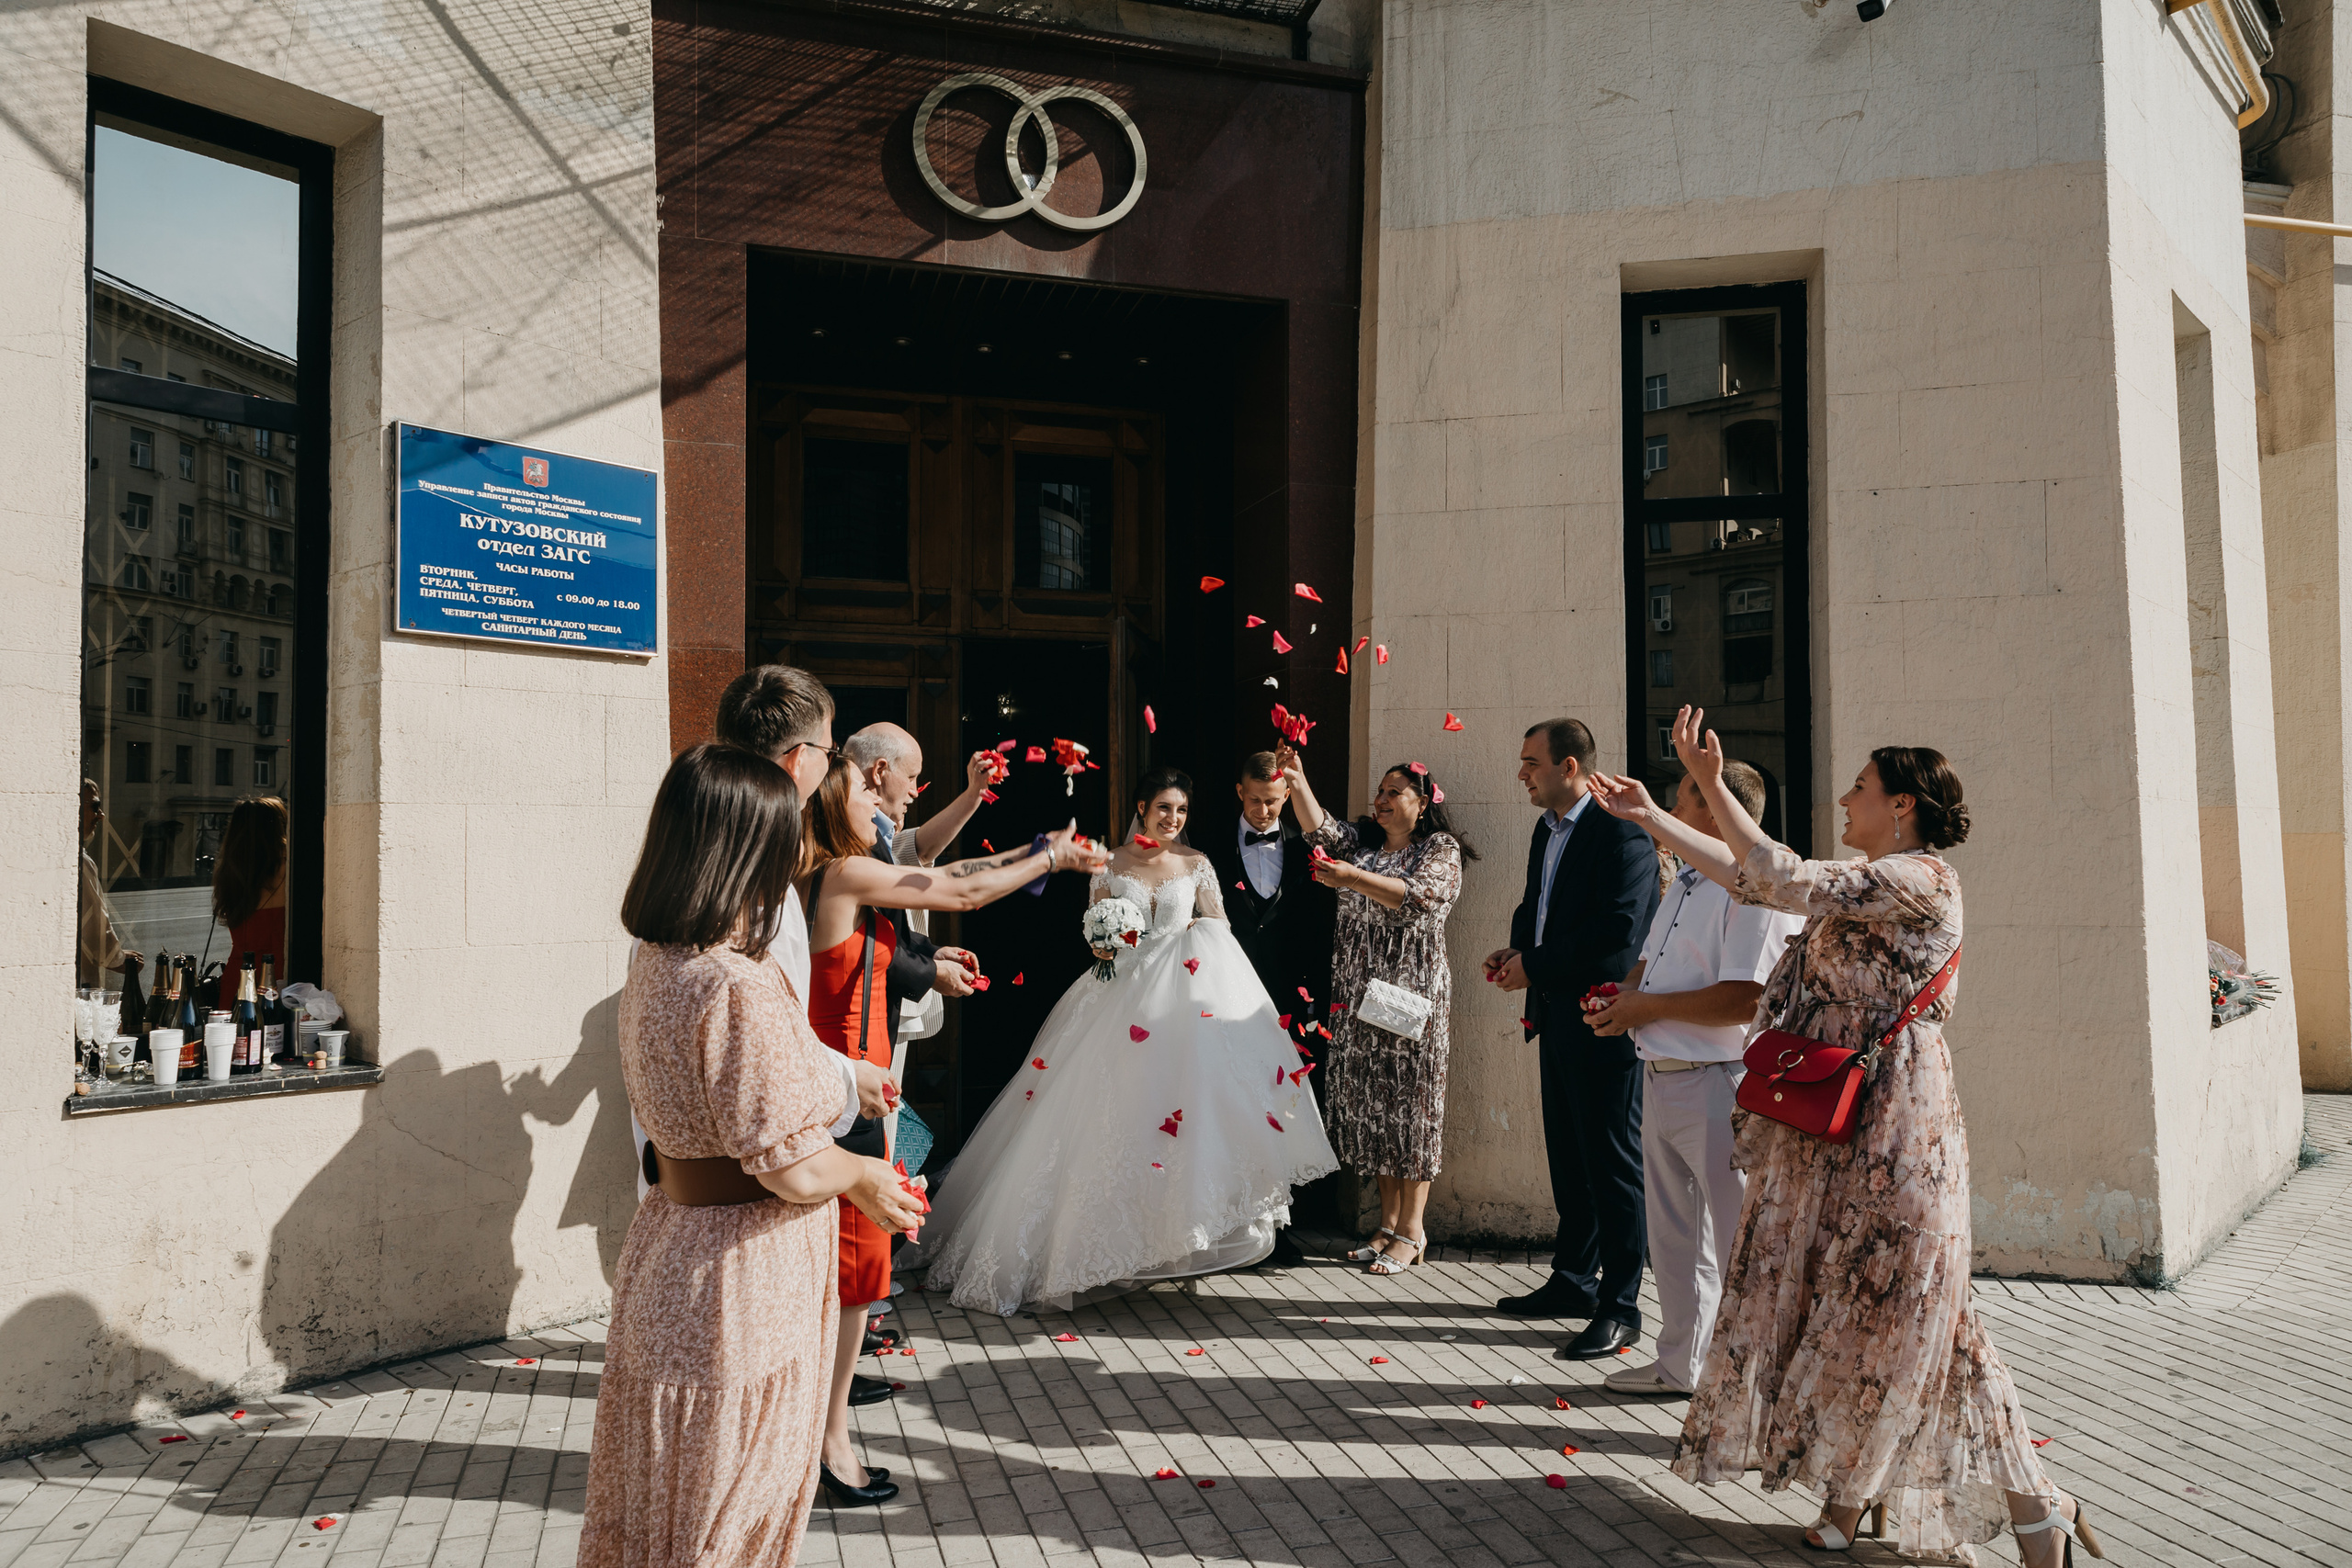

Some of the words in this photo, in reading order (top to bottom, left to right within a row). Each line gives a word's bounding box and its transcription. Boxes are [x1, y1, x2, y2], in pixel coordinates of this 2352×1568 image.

[418, 479, 475, 496] Управление
[476, 491, 509, 502] записи
[510, 497, 537, 506] актов
[537, 501, 599, 516] гражданского
[599, 511, 642, 525] состояния
[483, 482, 550, 501] Правительство
[551, 494, 586, 506] Москвы
[502, 502, 533, 513] города
[534, 507, 570, 519] Москвы
[459, 513, 606, 548] КУТУЗОВСКИЙ
[477, 538, 536, 557] отдел
[540, 544, 591, 565] ЗАГС
[420, 564, 478, 580] ВТОРНИК,
[496, 562, 528, 574] ЧАСЫ
[531, 567, 574, 581] РАБОТЫ
[419, 576, 463, 590] СРЕДА,
[467, 581, 519, 597] ЧЕТВЕРГ,
[420, 587, 480, 603] ПЯТНИЦА,
[483, 595, 535, 609] СУББОТА
[565, 593, 595, 605] 09.00
[596, 599, 610, 607] до
[613, 600, 640, 611] 18.00
[441, 607, 497, 620] ЧЕТВЕРТЫЙ
[500, 614, 539, 625] ЧЕТВЕРГ
[540, 618, 586, 630] КАЖДОГО
[587, 624, 622, 634] МЕСЯЦА
[481, 622, 557, 637] САНИТАРНЫЙ
[559, 630, 587, 640] ДЕНЬ
